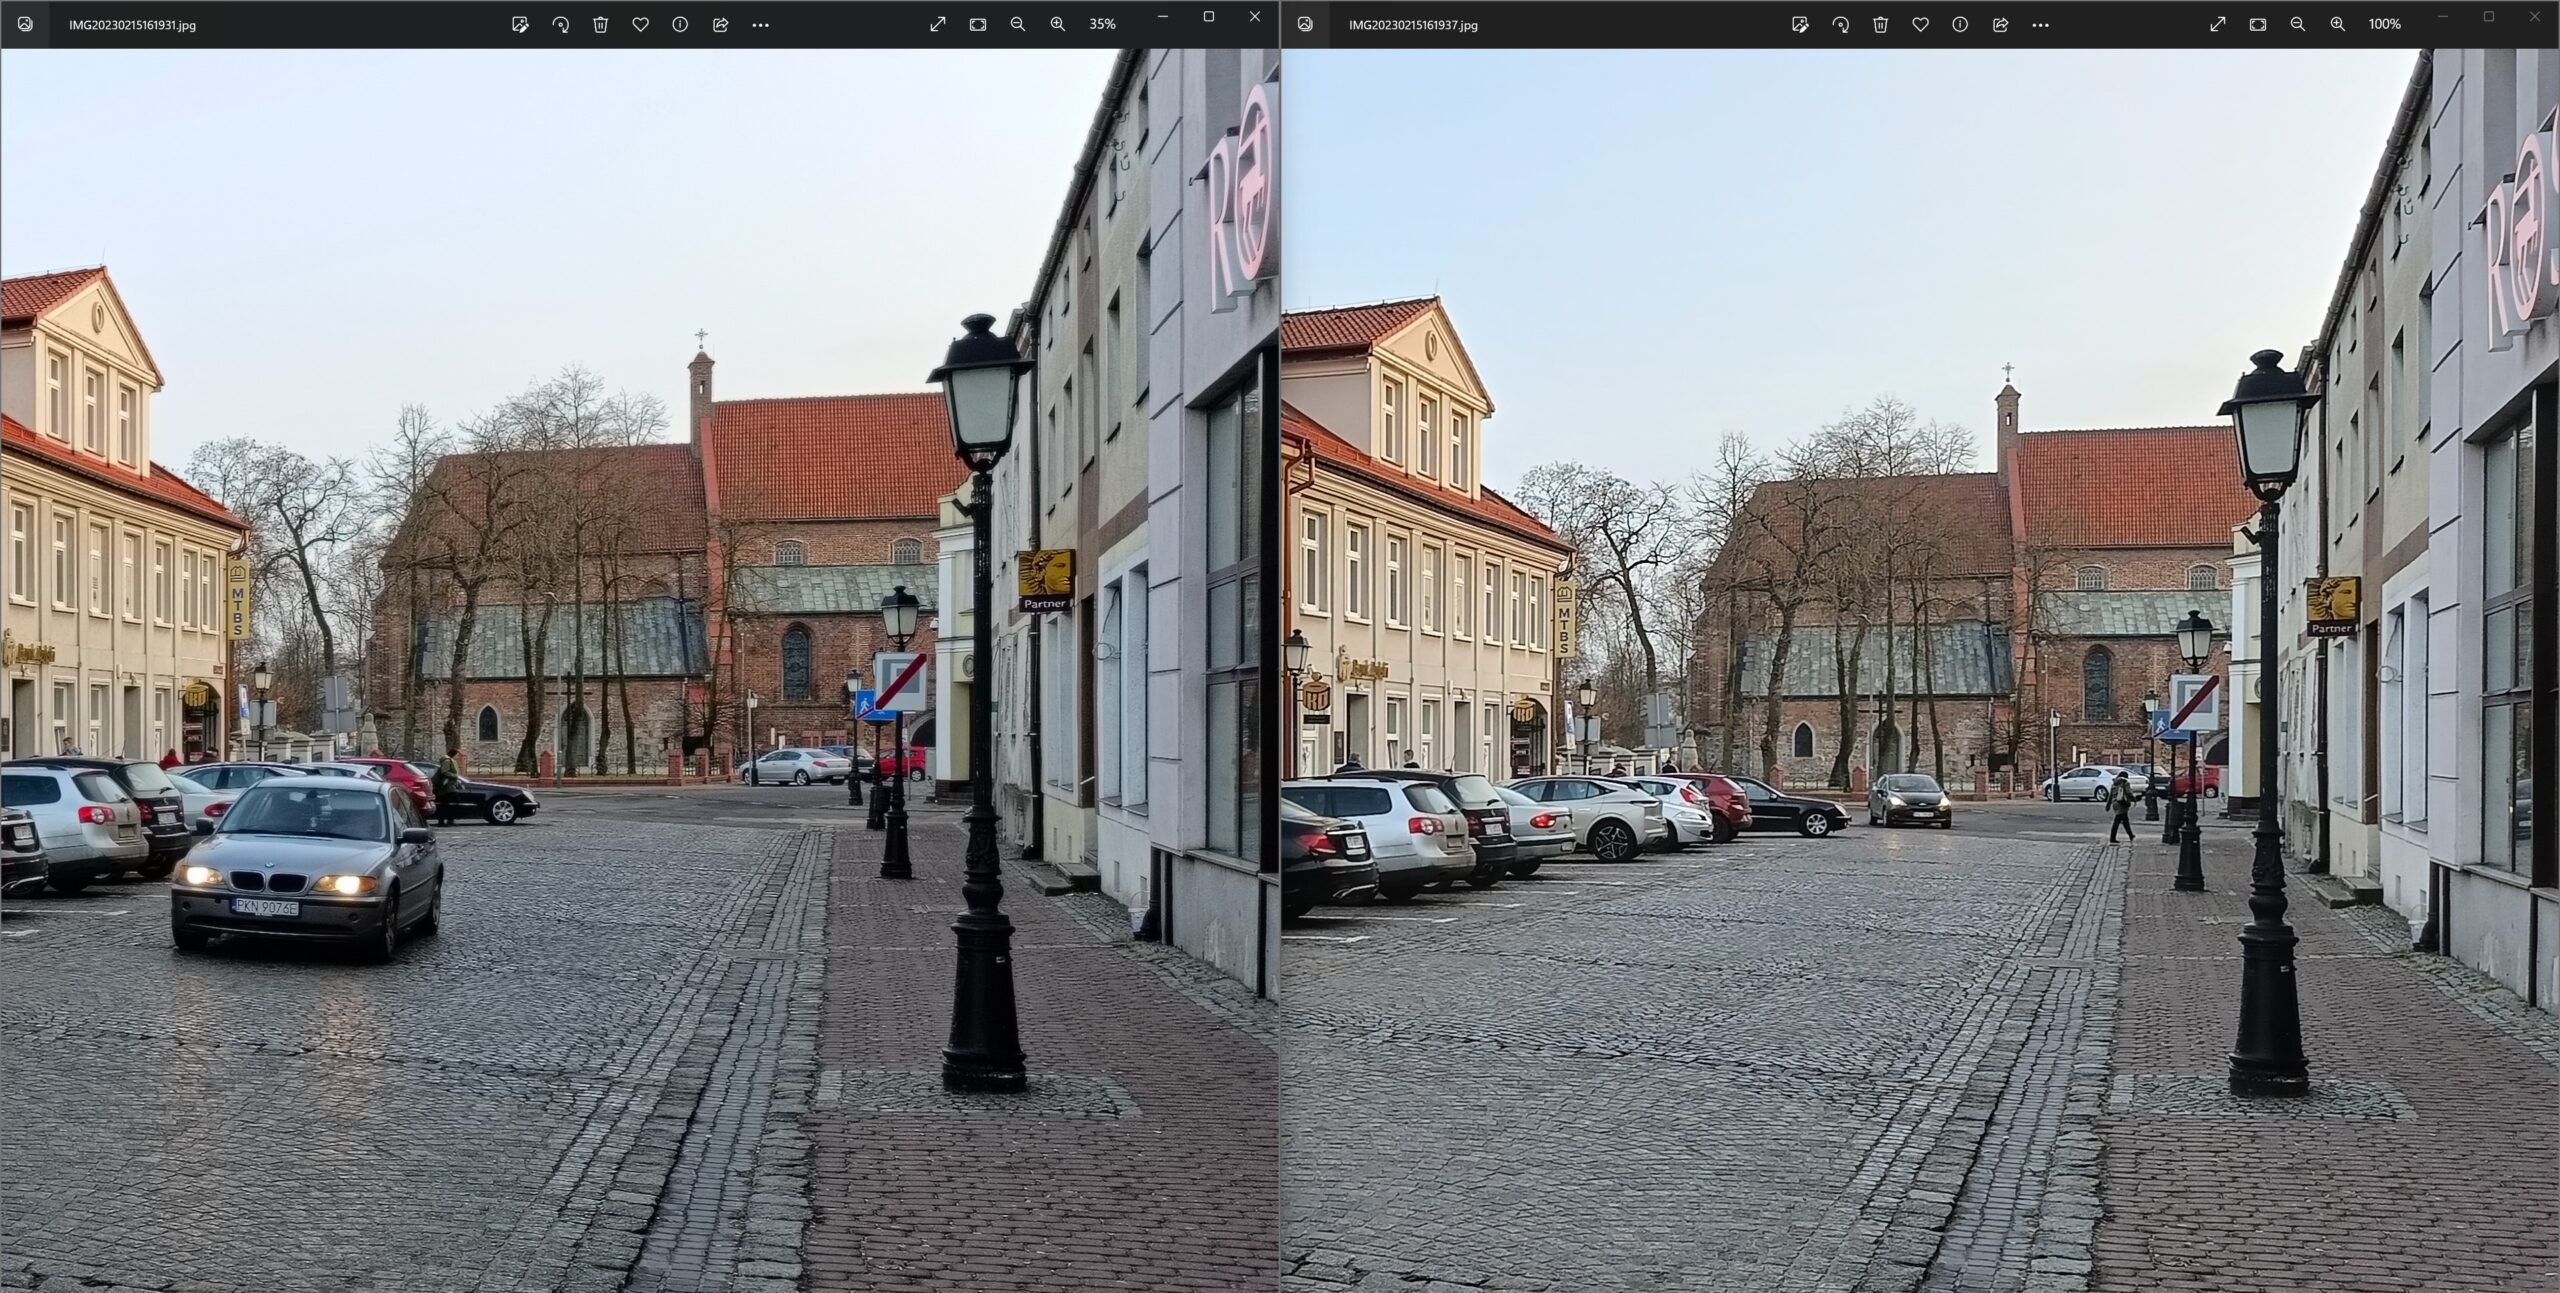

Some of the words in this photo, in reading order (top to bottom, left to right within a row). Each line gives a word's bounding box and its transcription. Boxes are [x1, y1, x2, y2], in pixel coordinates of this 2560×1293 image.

[69, 20, 197, 33] IMG20230215161931.jpg
[1089, 18, 1117, 30] 35%
[1349, 20, 1479, 33] IMG20230215161937.jpg
[2369, 18, 2402, 30] 100%
[1024, 599, 1067, 609] Partner
[232, 588, 244, 636] MTBS
[1559, 608, 1570, 654] MTBS
[2312, 624, 2353, 634] Partner
[237, 899, 259, 912] PKN
[262, 901, 298, 915] 9076E
